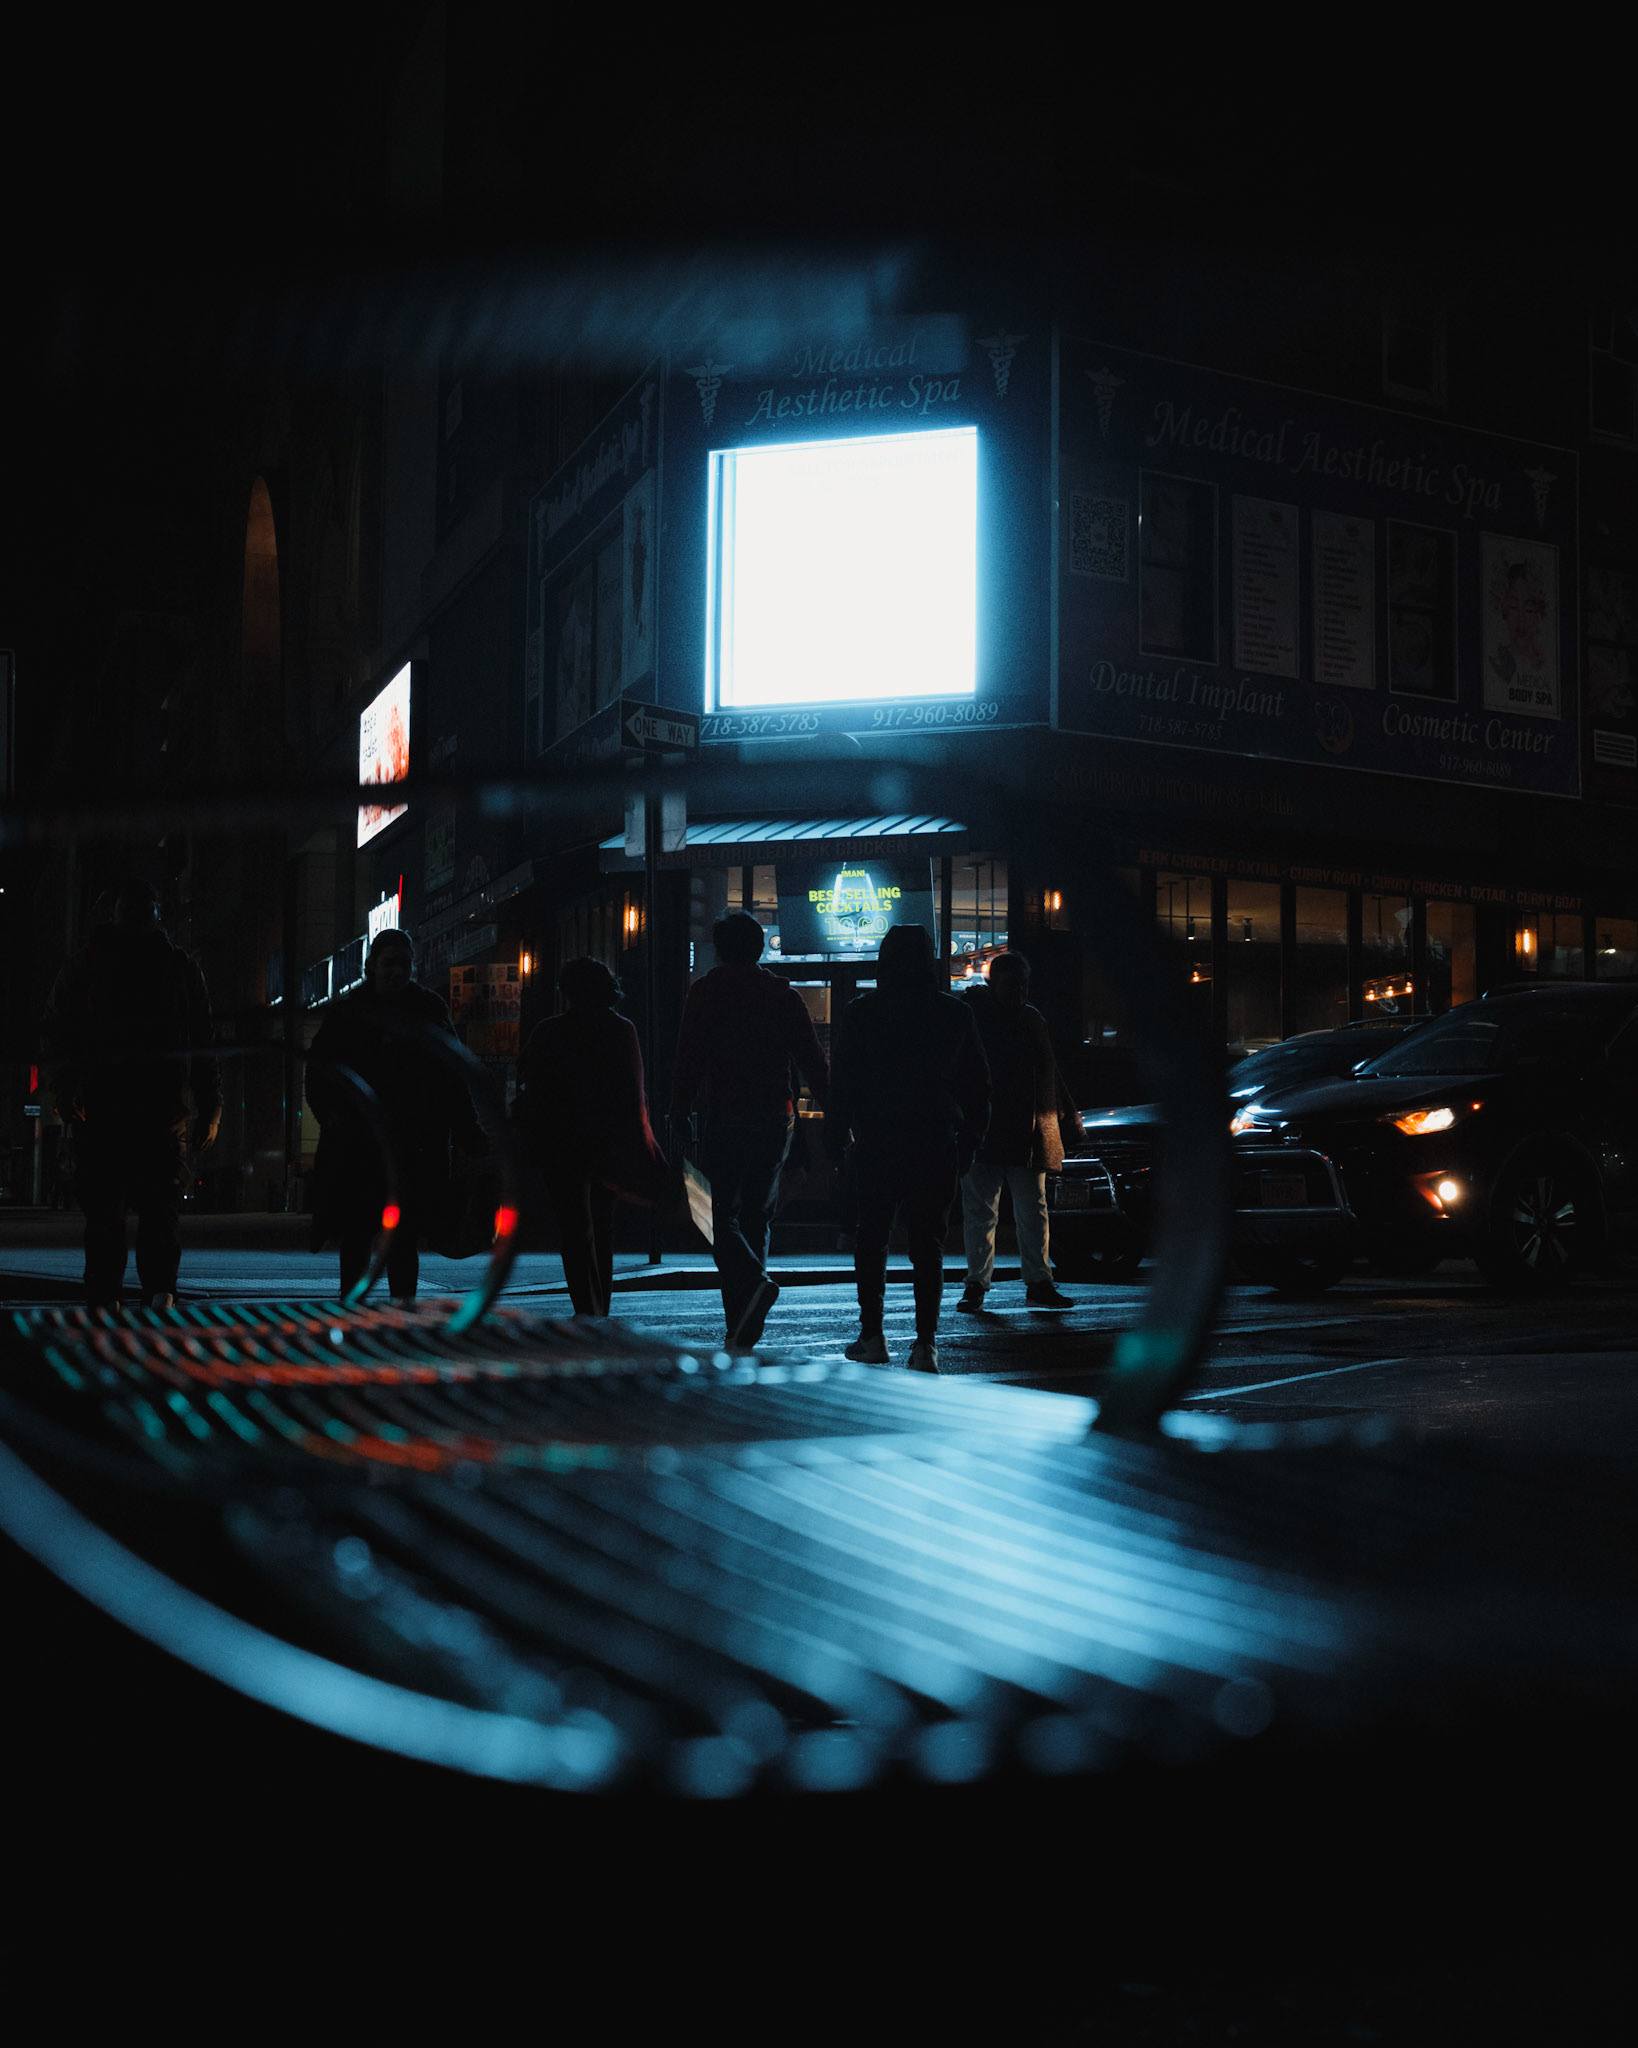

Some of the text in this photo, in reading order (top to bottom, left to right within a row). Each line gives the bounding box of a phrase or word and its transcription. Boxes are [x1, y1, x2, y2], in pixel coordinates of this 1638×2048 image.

[793, 333, 918, 378] Medical
[745, 375, 962, 426] Aesthetic Spa
[1144, 400, 1503, 520] Medical Aesthetic Spa
[1090, 660, 1286, 721] Dental Implant
[1509, 686, 1553, 707] BODY SPA
[700, 712, 821, 736] 718-587-5785
[872, 702, 998, 728] 917-960-8089
[634, 716, 691, 744] ONE WAY
[1382, 703, 1556, 754] Cosmetic Center
[790, 840, 831, 858] JERK
[834, 838, 908, 856] CHICKEN
[841, 869, 866, 878] IMANI
[1138, 849, 1583, 911] JERK CHICKEN OXTAIL CURRY GOAT CURRY CHICKEN OXTAIL CURRY GOAT
[808, 886, 902, 902] BEST SELLING
[815, 899, 893, 914] COCKTAILS
[824, 914, 889, 936] TO GO
